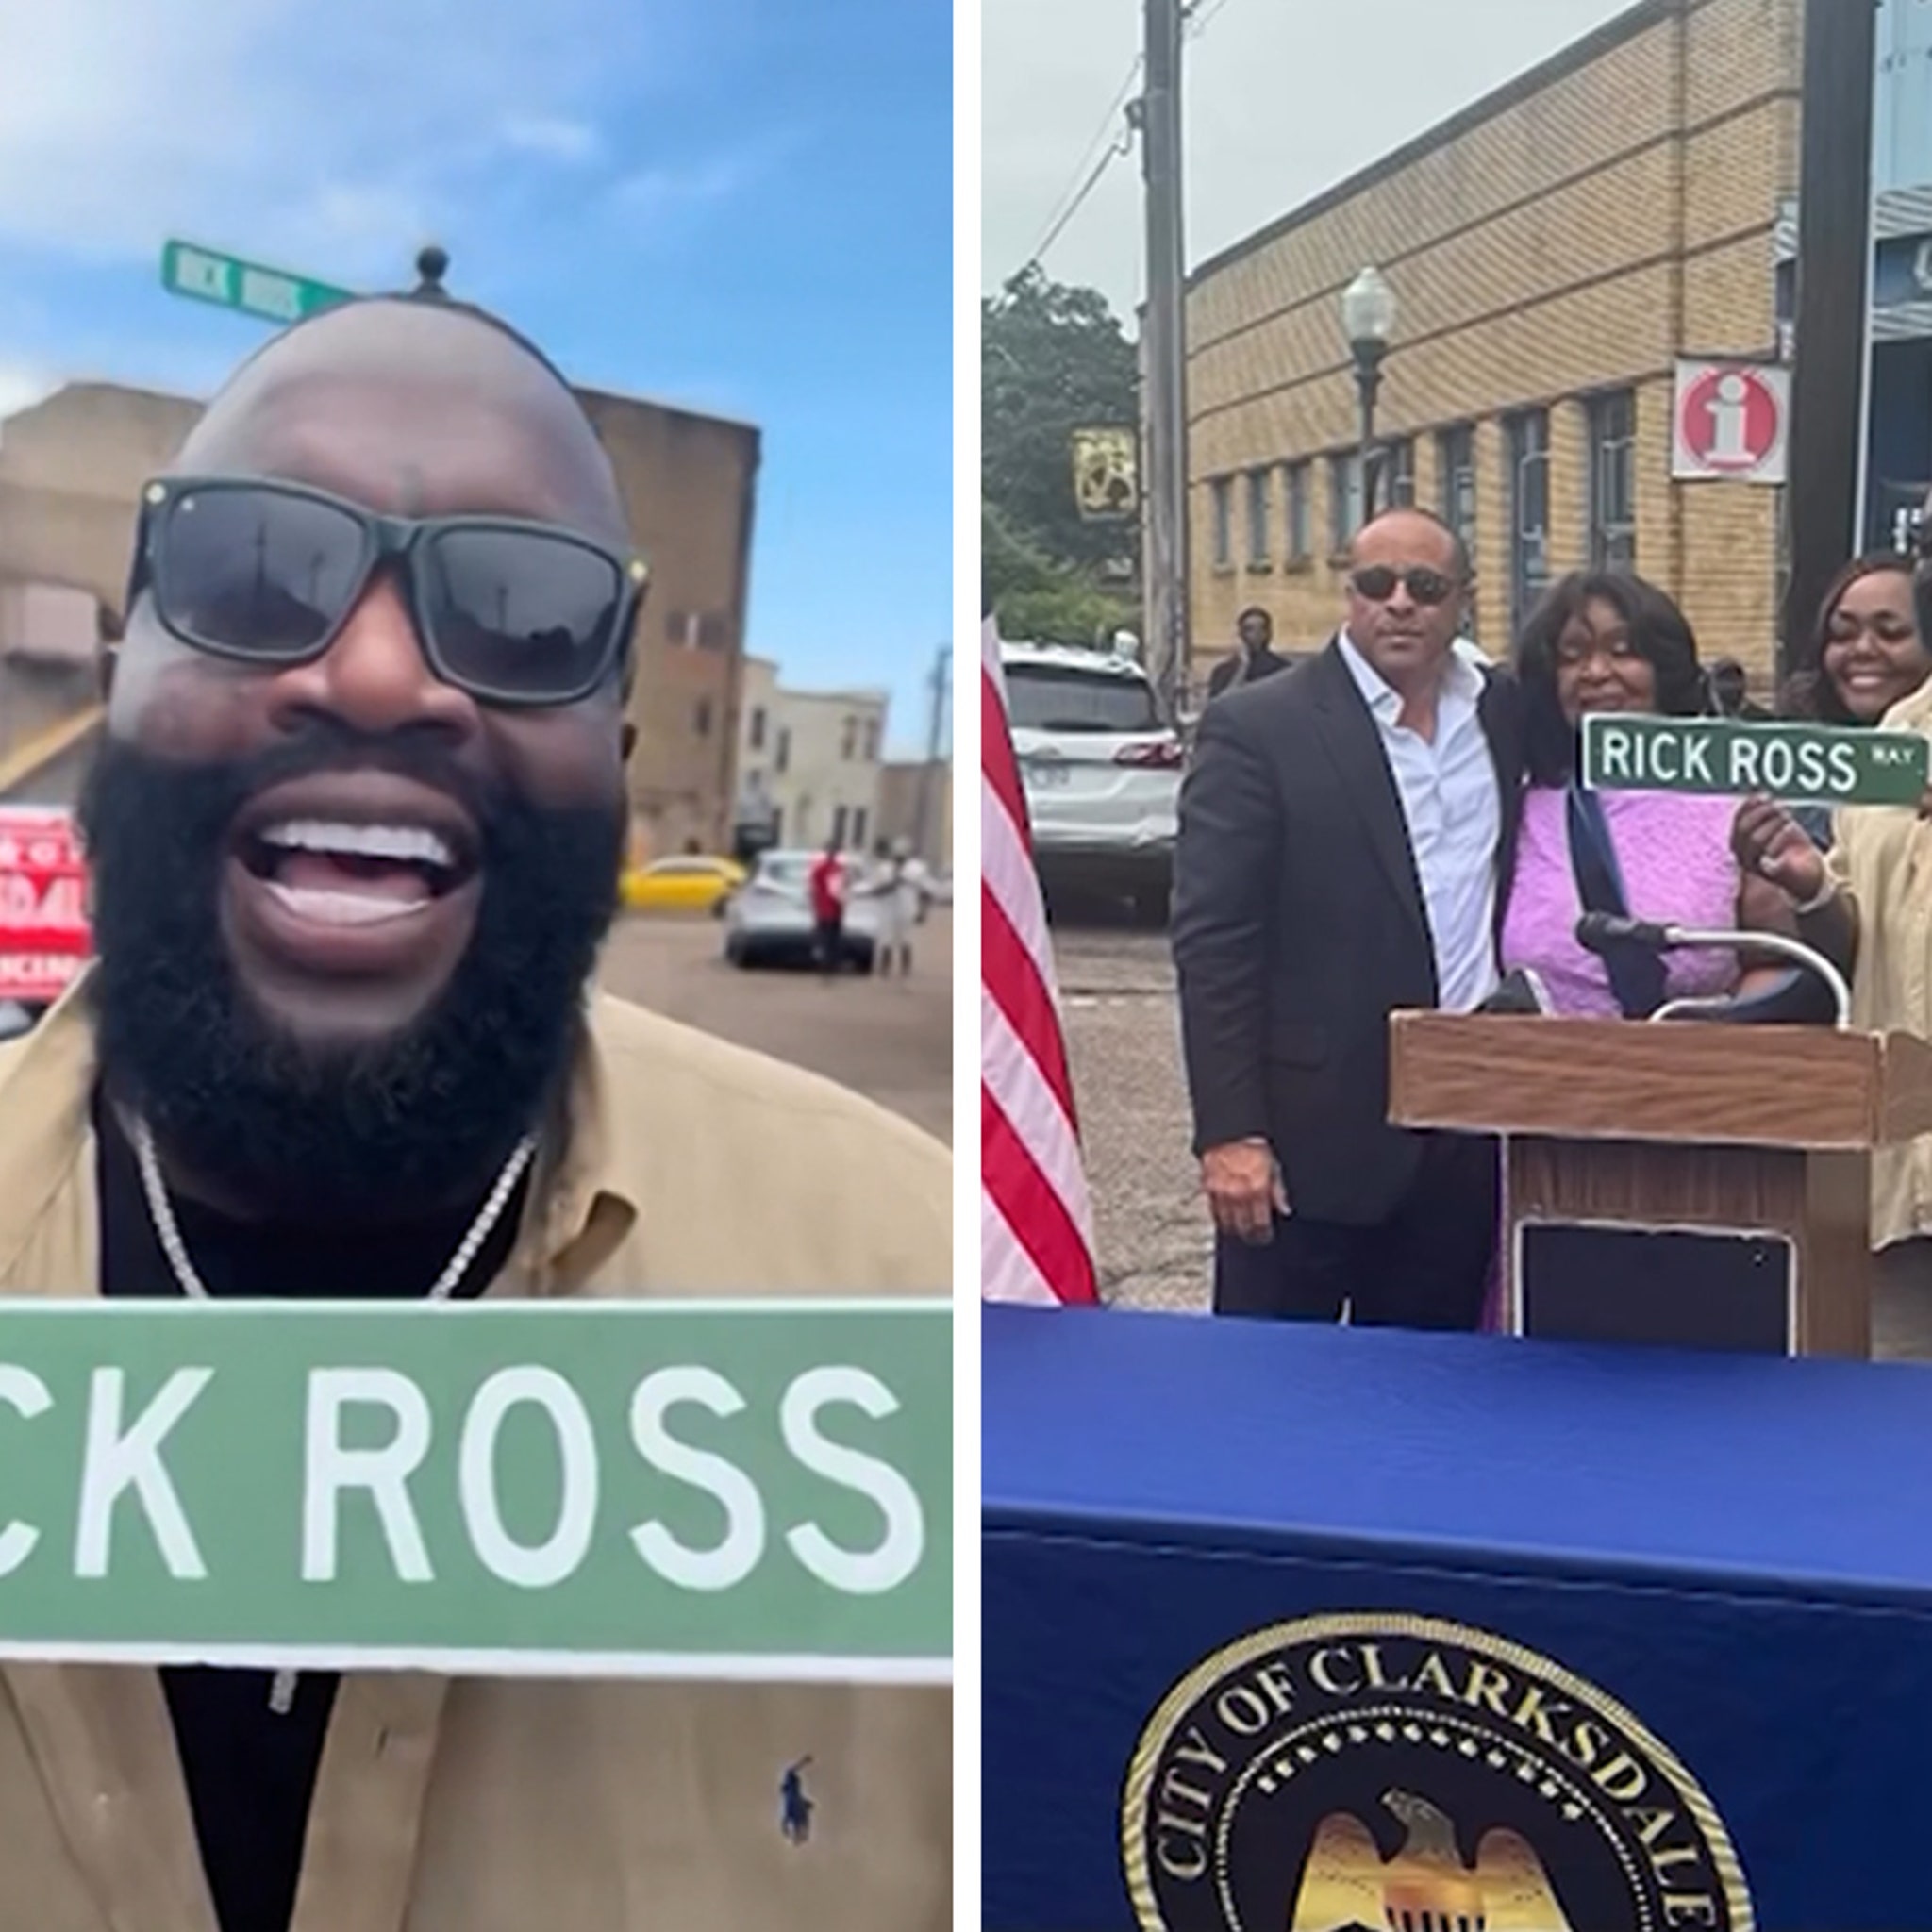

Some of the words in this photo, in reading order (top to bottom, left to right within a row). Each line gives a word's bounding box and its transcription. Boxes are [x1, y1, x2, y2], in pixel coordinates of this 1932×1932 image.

[1603, 729, 1712, 782] RICK
[1730, 739, 1857, 791] ROSS
[301, 1363, 925, 1594] ROSS
[1157, 1727, 1227, 1880] CITY
[1217, 1663, 1298, 1735] OF
[1309, 1644, 1716, 1928] CLARKSDALE
